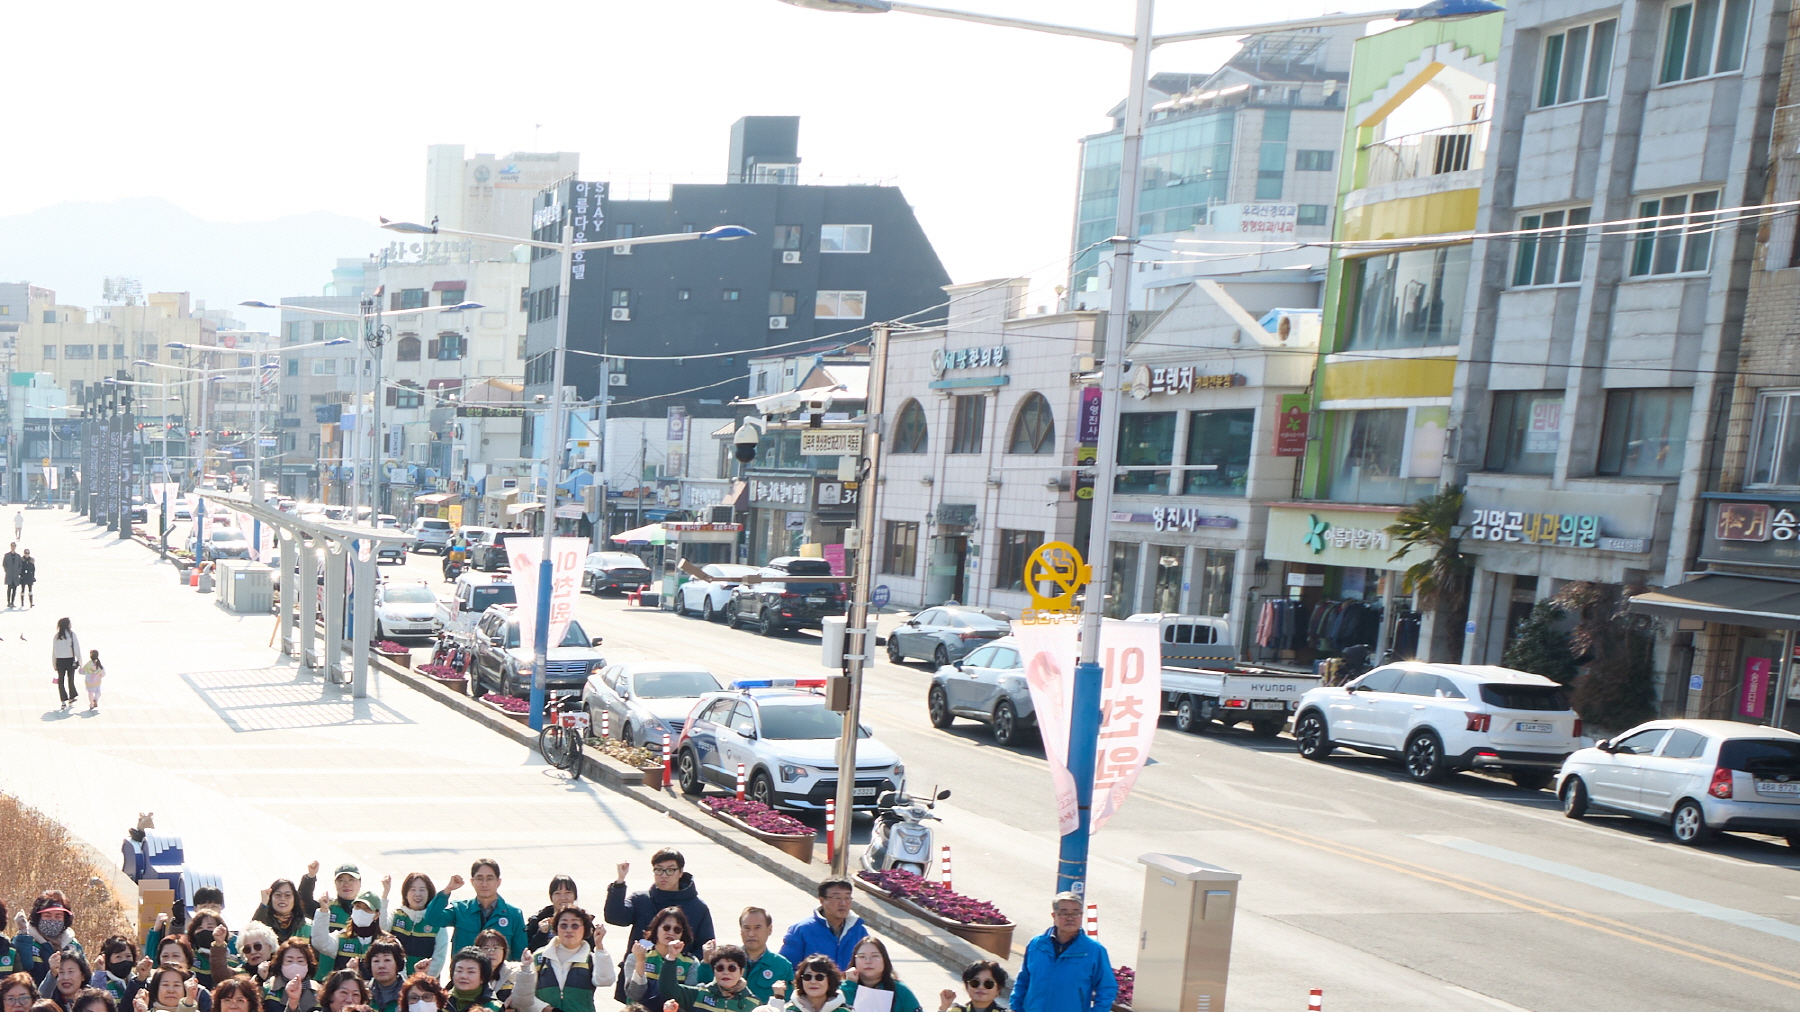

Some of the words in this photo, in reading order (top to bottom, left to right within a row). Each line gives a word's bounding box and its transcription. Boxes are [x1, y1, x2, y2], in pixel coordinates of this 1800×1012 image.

[593, 182, 605, 231] STAY
[944, 346, 1008, 369] 세광한의원
[1151, 366, 1195, 395] 프렌치
[1087, 406, 1099, 436] 영진사
[1152, 506, 1198, 532] 영진사
[1472, 509, 1599, 548] 김명곤내과의원
[1720, 506, 1766, 537] 松月
[1771, 508, 1800, 541] 송
[1324, 527, 1389, 550] 아름다운가게
[1022, 606, 1080, 626] 금연구역
[1251, 683, 1296, 692] HYUNDAI
